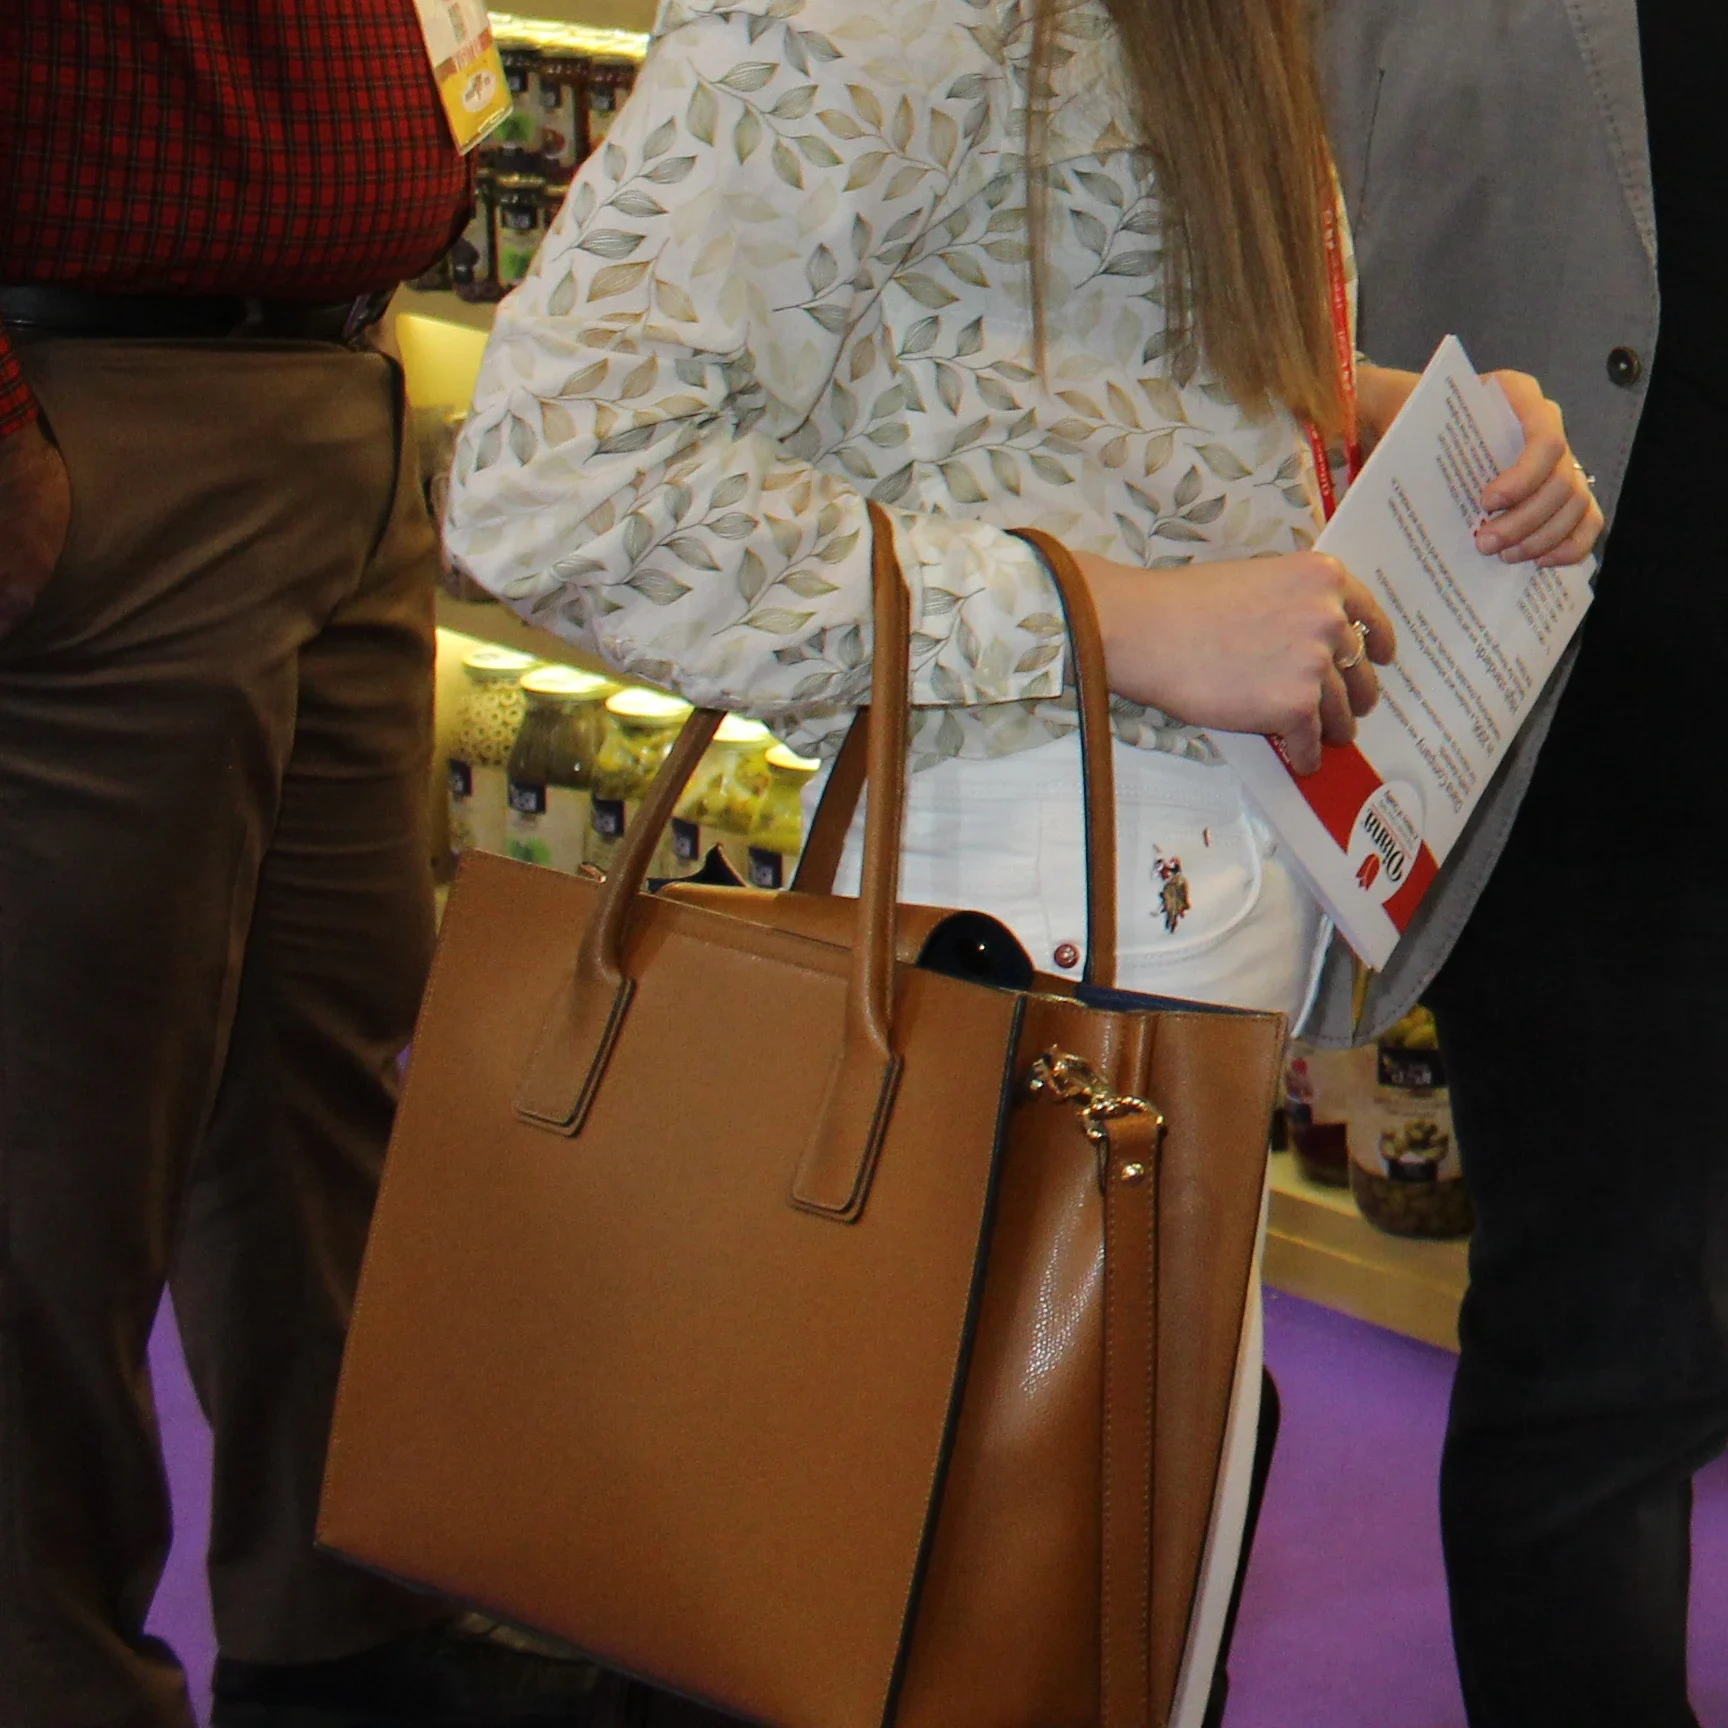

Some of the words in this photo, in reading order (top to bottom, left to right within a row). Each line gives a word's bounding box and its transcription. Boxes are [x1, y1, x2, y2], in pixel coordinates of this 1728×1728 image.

[1472, 639, 1506, 698] standards
[1413, 732, 1450, 791] Company
[1363, 809, 1405, 885] Diana
